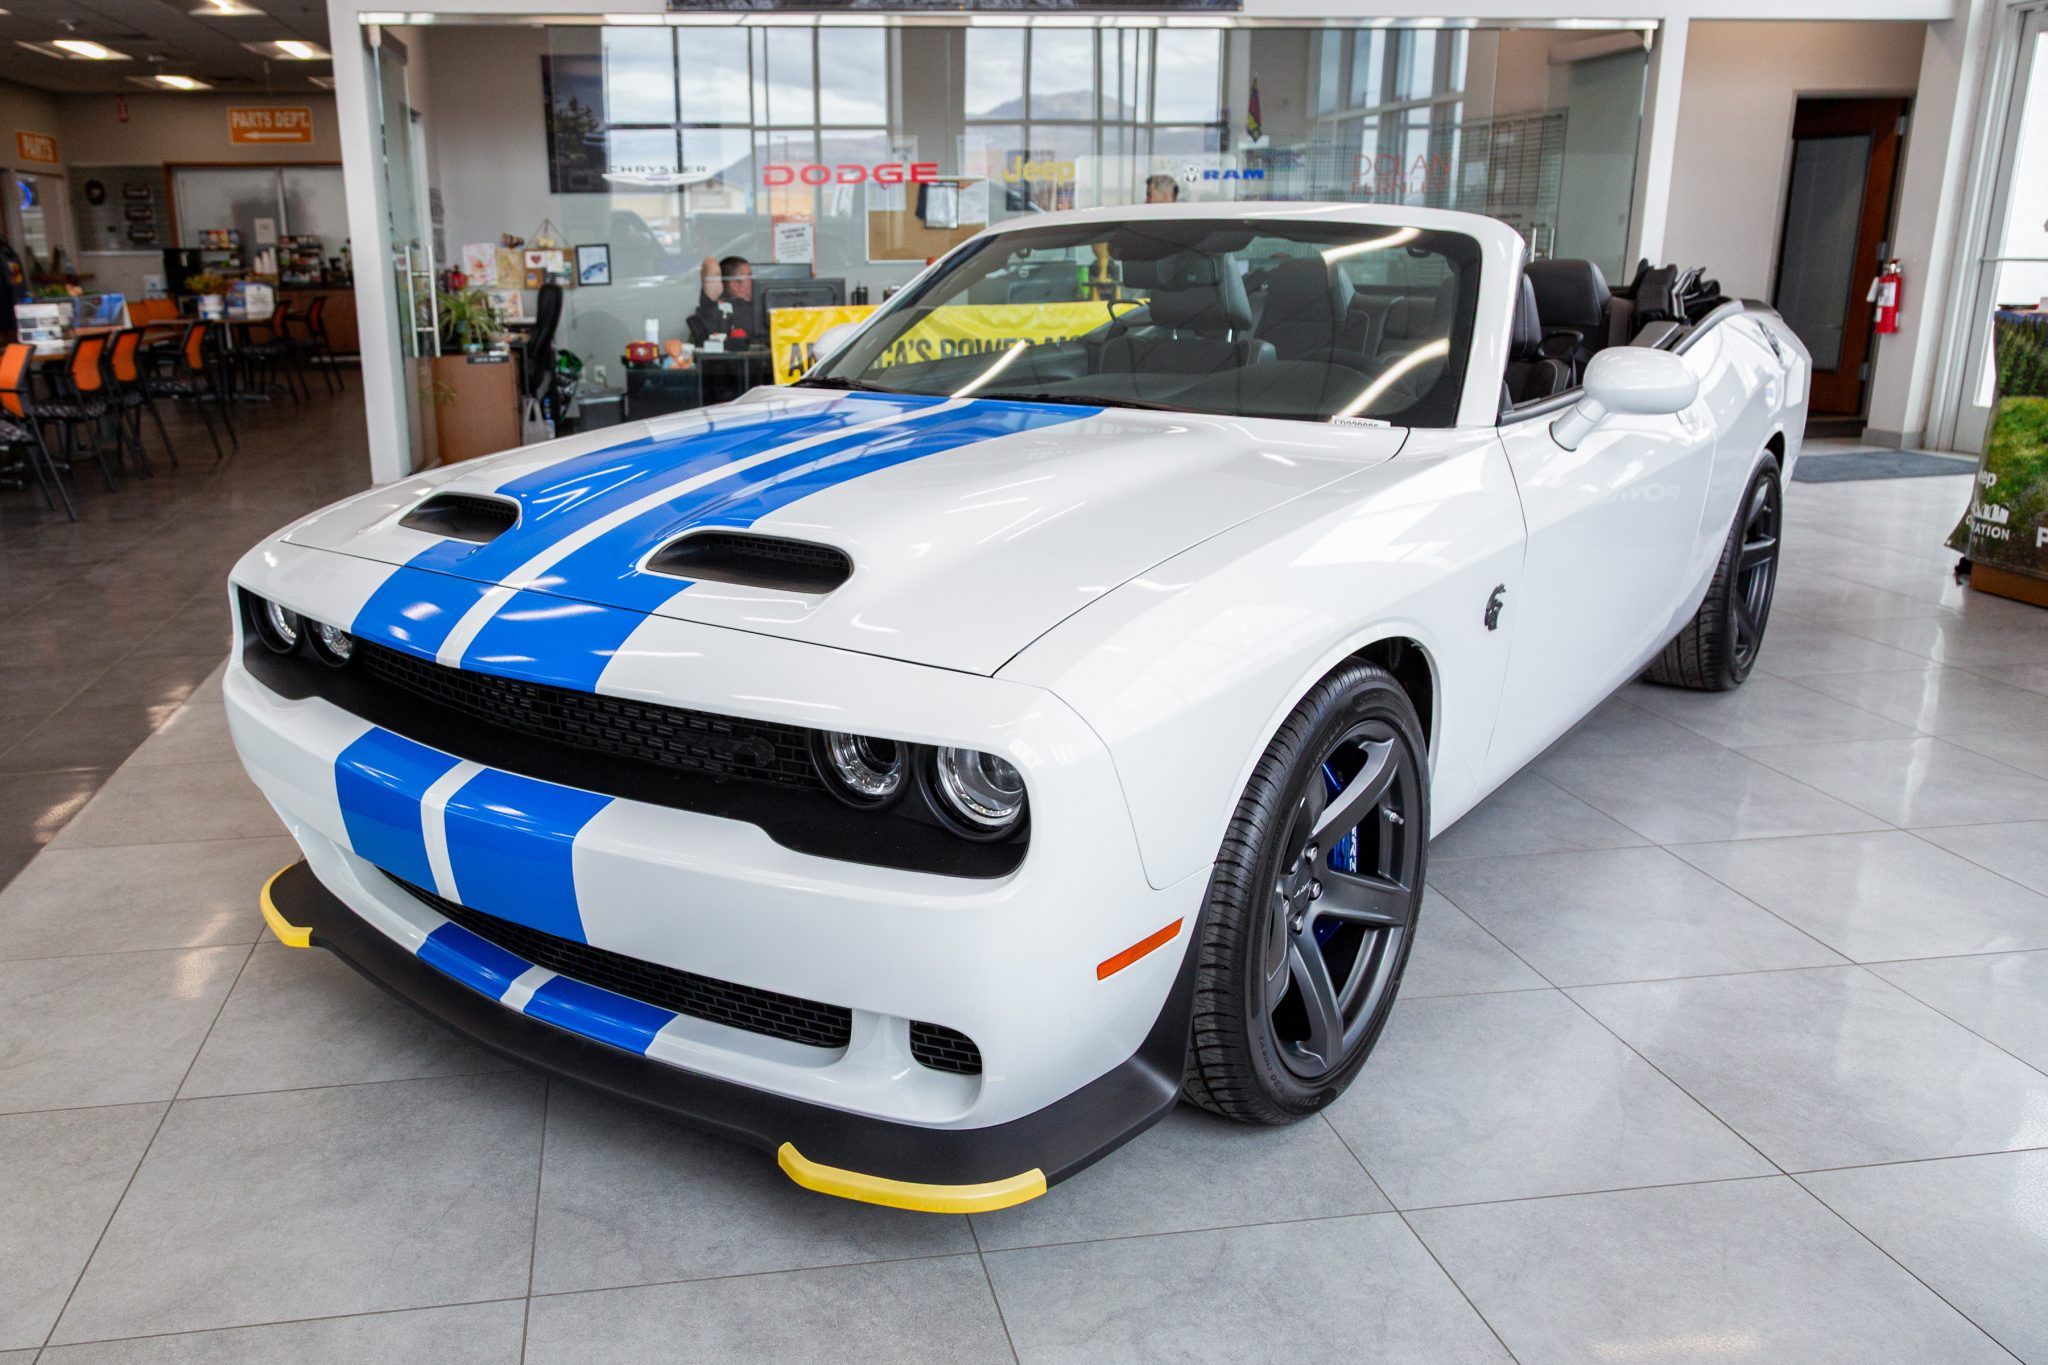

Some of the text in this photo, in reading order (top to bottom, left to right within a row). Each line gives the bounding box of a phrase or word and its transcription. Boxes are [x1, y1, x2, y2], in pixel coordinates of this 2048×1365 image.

[232, 111, 310, 128] PARTS DEPT.
[608, 165, 707, 173] CHRYSLER
[763, 162, 939, 186] DODGE
[1003, 155, 1076, 184] Jeep
[1203, 169, 1265, 180] RAM
[1352, 153, 1451, 177] DOLAN
